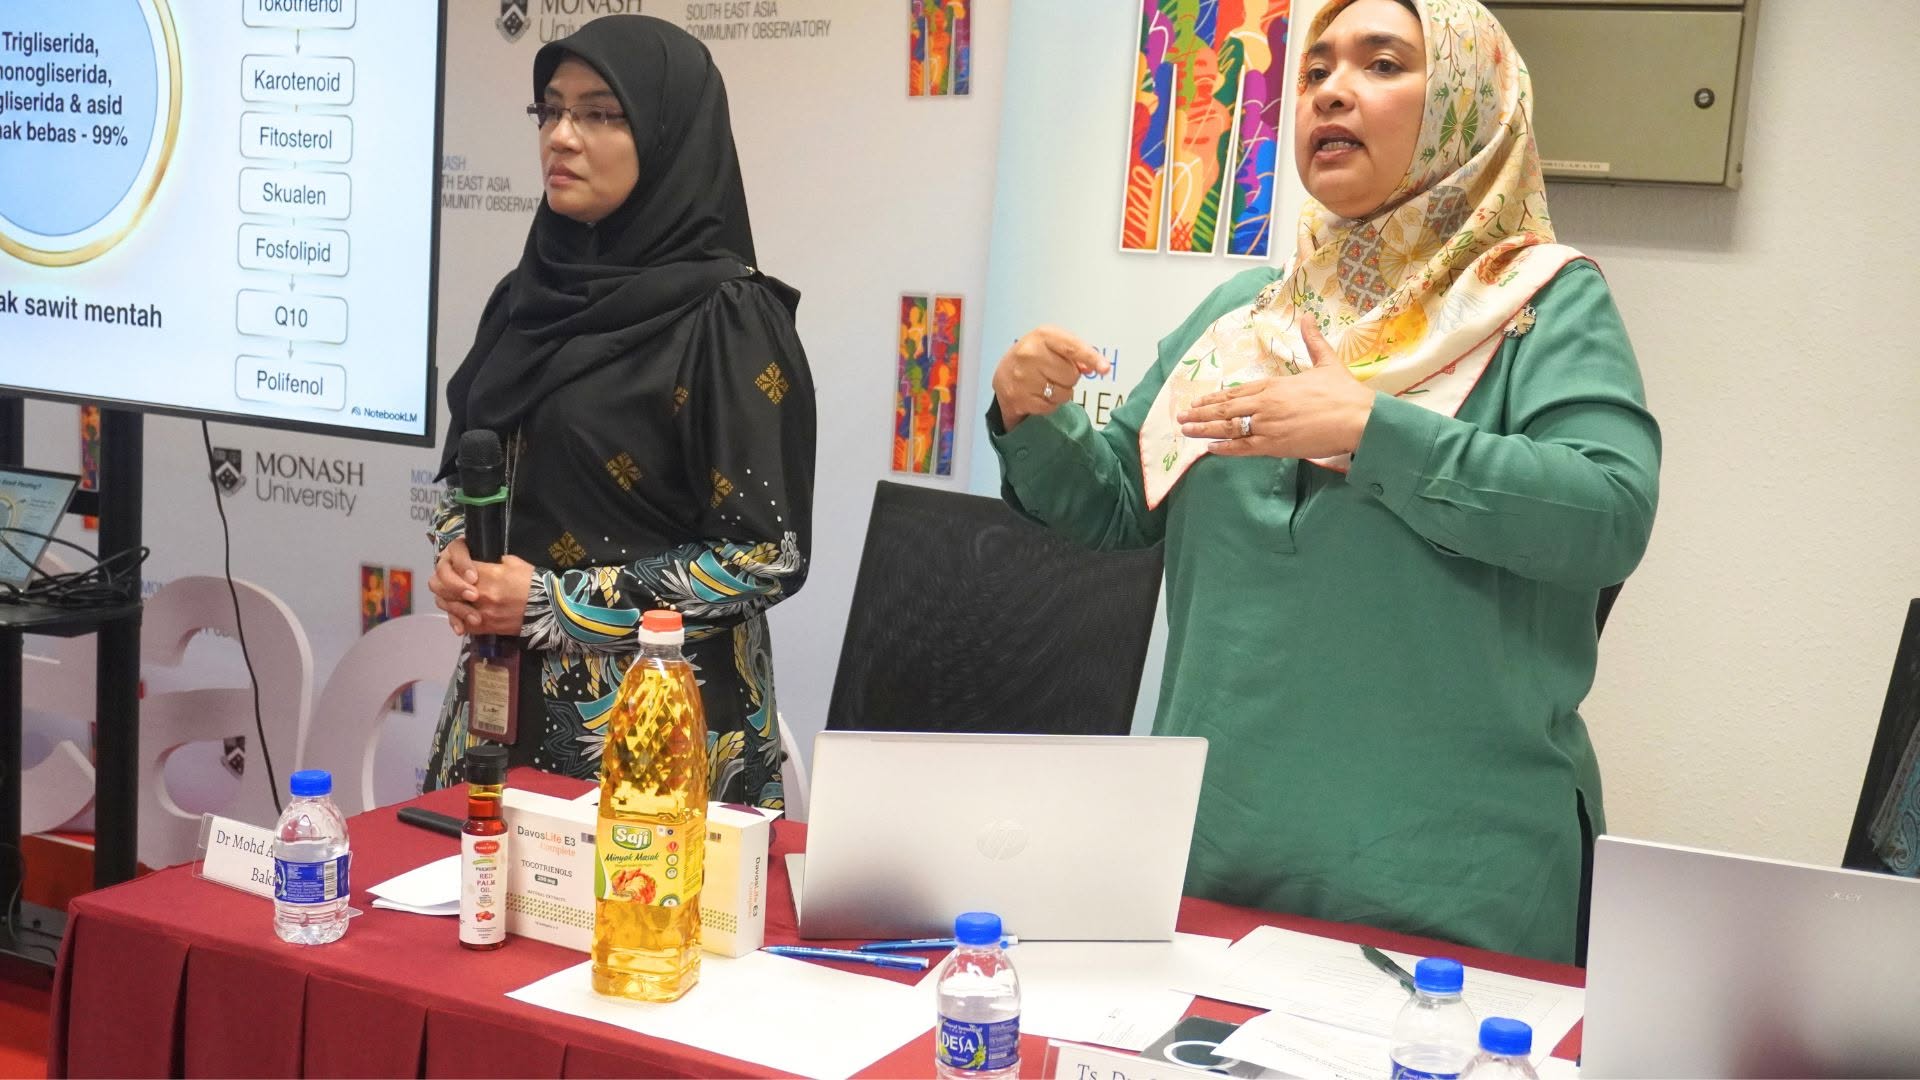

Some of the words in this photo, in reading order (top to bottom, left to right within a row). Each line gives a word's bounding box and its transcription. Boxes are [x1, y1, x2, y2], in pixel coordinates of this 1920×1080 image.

[686, 3, 721, 20] SOUTH
[724, 2, 751, 19] EAST
[753, 1, 778, 17] ASIA
[752, 20, 831, 39] OBSERVATORY
[2, 31, 99, 57] Trigliserida,
[254, 69, 340, 92] Karotenoid
[70, 93, 81, 113] &
[87, 94, 122, 115] asid
[27, 121, 76, 143] bebas
[92, 124, 128, 146] 99%
[260, 126, 332, 149] Fitosterol
[263, 182, 326, 205] Skualen
[457, 174, 484, 191] EAST
[486, 176, 510, 192] ASIA
[485, 195, 541, 213] OBSERVAT
[256, 237, 331, 265] Fosfolipid
[25, 296, 78, 320] sawit
[85, 303, 162, 328] mentah
[275, 305, 308, 328] Q10
[257, 370, 323, 395] Polifenol
[364, 407, 418, 422] NotebookLM
[256, 451, 364, 486] MONASH
[256, 477, 357, 517] University
[216, 830, 231, 845] Dr
[232, 834, 265, 855] Mohd
[517, 825, 562, 844] DavosLife
[564, 836, 576, 847] E3
[615, 828, 649, 849] Saji
[521, 859, 573, 878] TOCOTRIENOLS
[604, 852, 633, 864] Minyak
[634, 852, 659, 861] Masak
[942, 1031, 976, 1054] DESA
